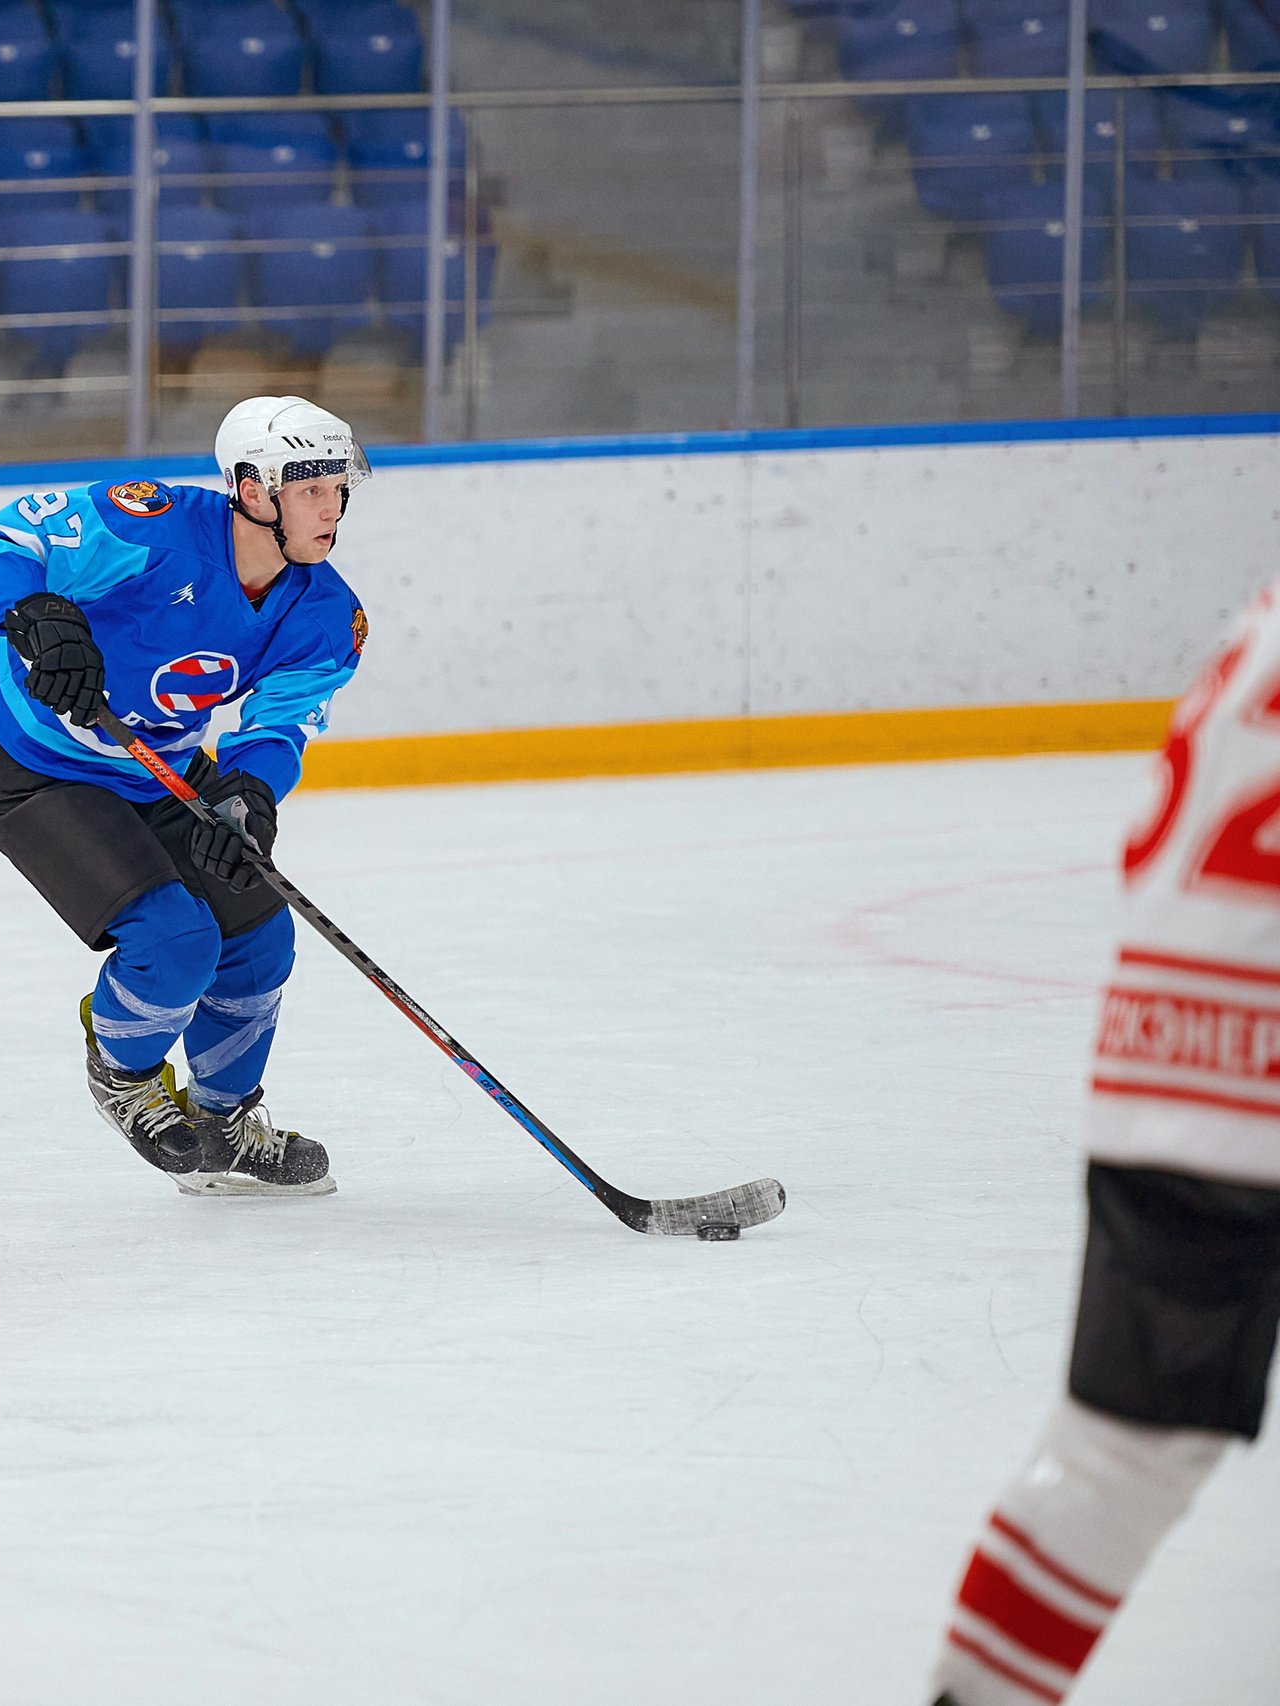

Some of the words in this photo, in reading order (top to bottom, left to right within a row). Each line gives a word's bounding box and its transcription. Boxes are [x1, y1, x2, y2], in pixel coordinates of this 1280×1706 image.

[245, 447, 264, 456] Reebok
[16, 490, 83, 549] 97
[498, 1096, 514, 1108] 40
